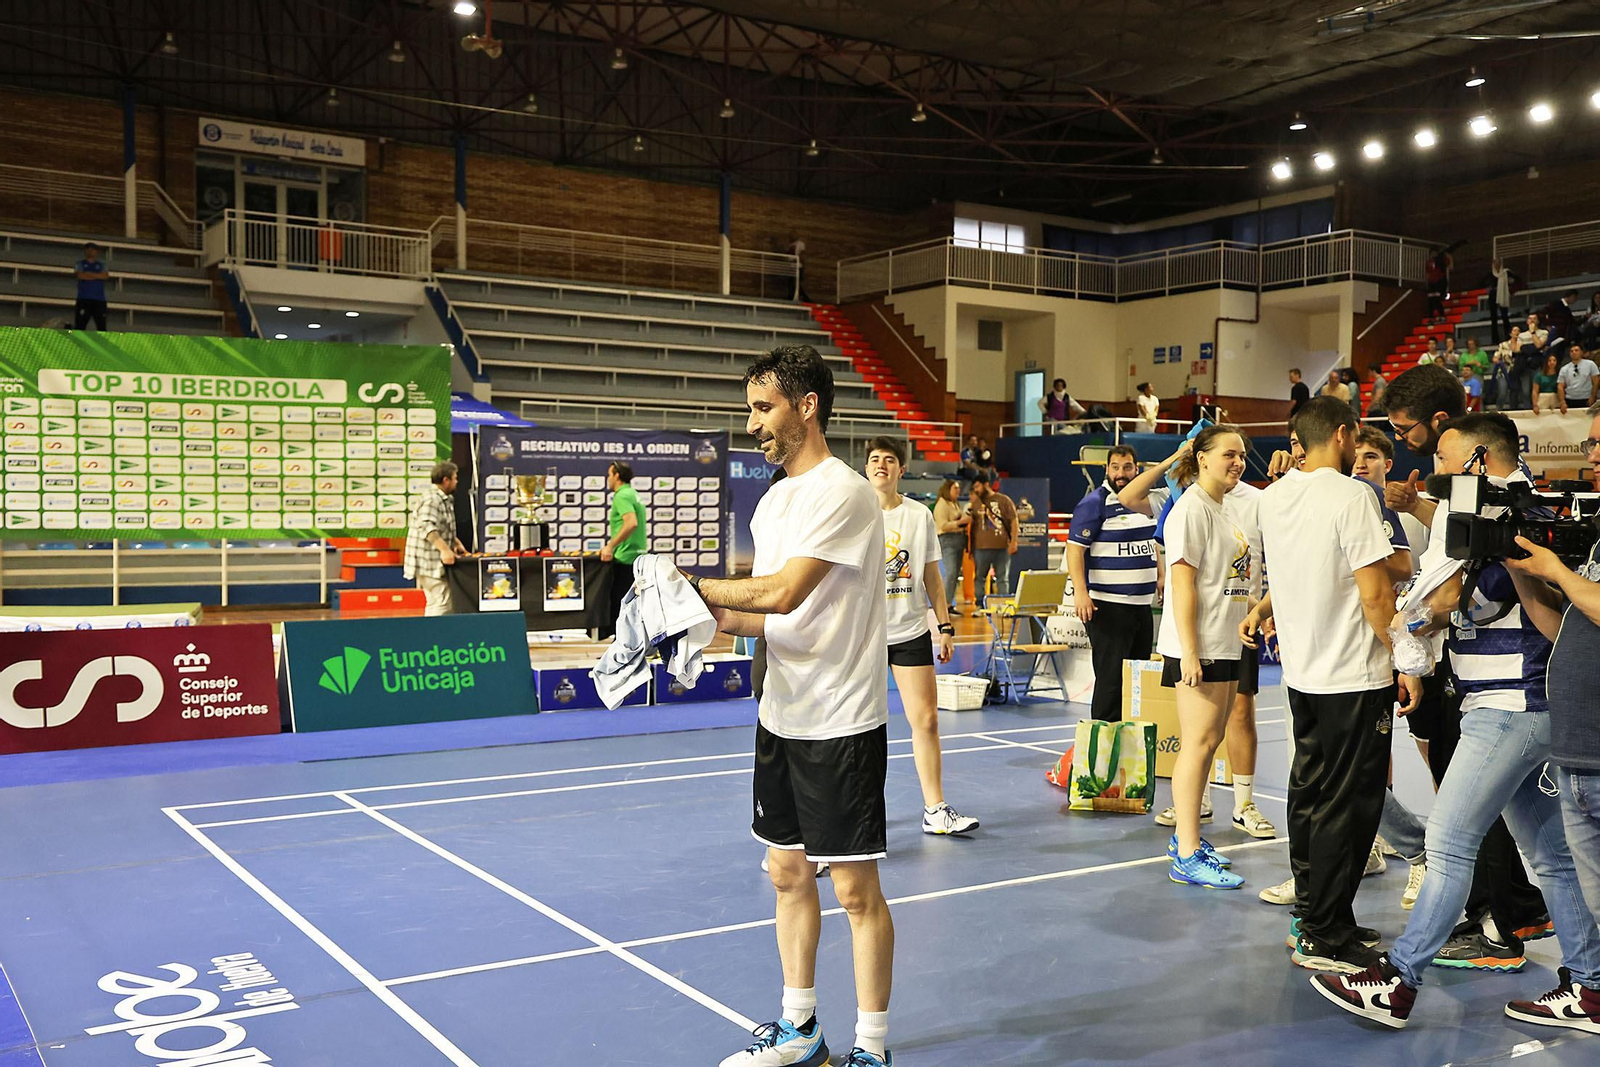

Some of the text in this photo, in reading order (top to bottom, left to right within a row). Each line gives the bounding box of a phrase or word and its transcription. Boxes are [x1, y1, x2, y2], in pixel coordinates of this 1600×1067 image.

[64, 373, 325, 400] TOP 10 IBERDROLA
[520, 440, 601, 453] RECREATIVO
[603, 442, 625, 454] IES
[627, 443, 645, 454] LA
[646, 443, 690, 455] ORDEN
[1535, 441, 1579, 454] Informa
[730, 461, 776, 480] Huelv
[378, 641, 506, 670] Fundación
[179, 675, 238, 691] Consejo
[381, 666, 475, 695] Unicaja
[181, 690, 243, 706] Superior
[181, 703, 269, 719] de Deportes
[207, 952, 279, 992] Huelva
